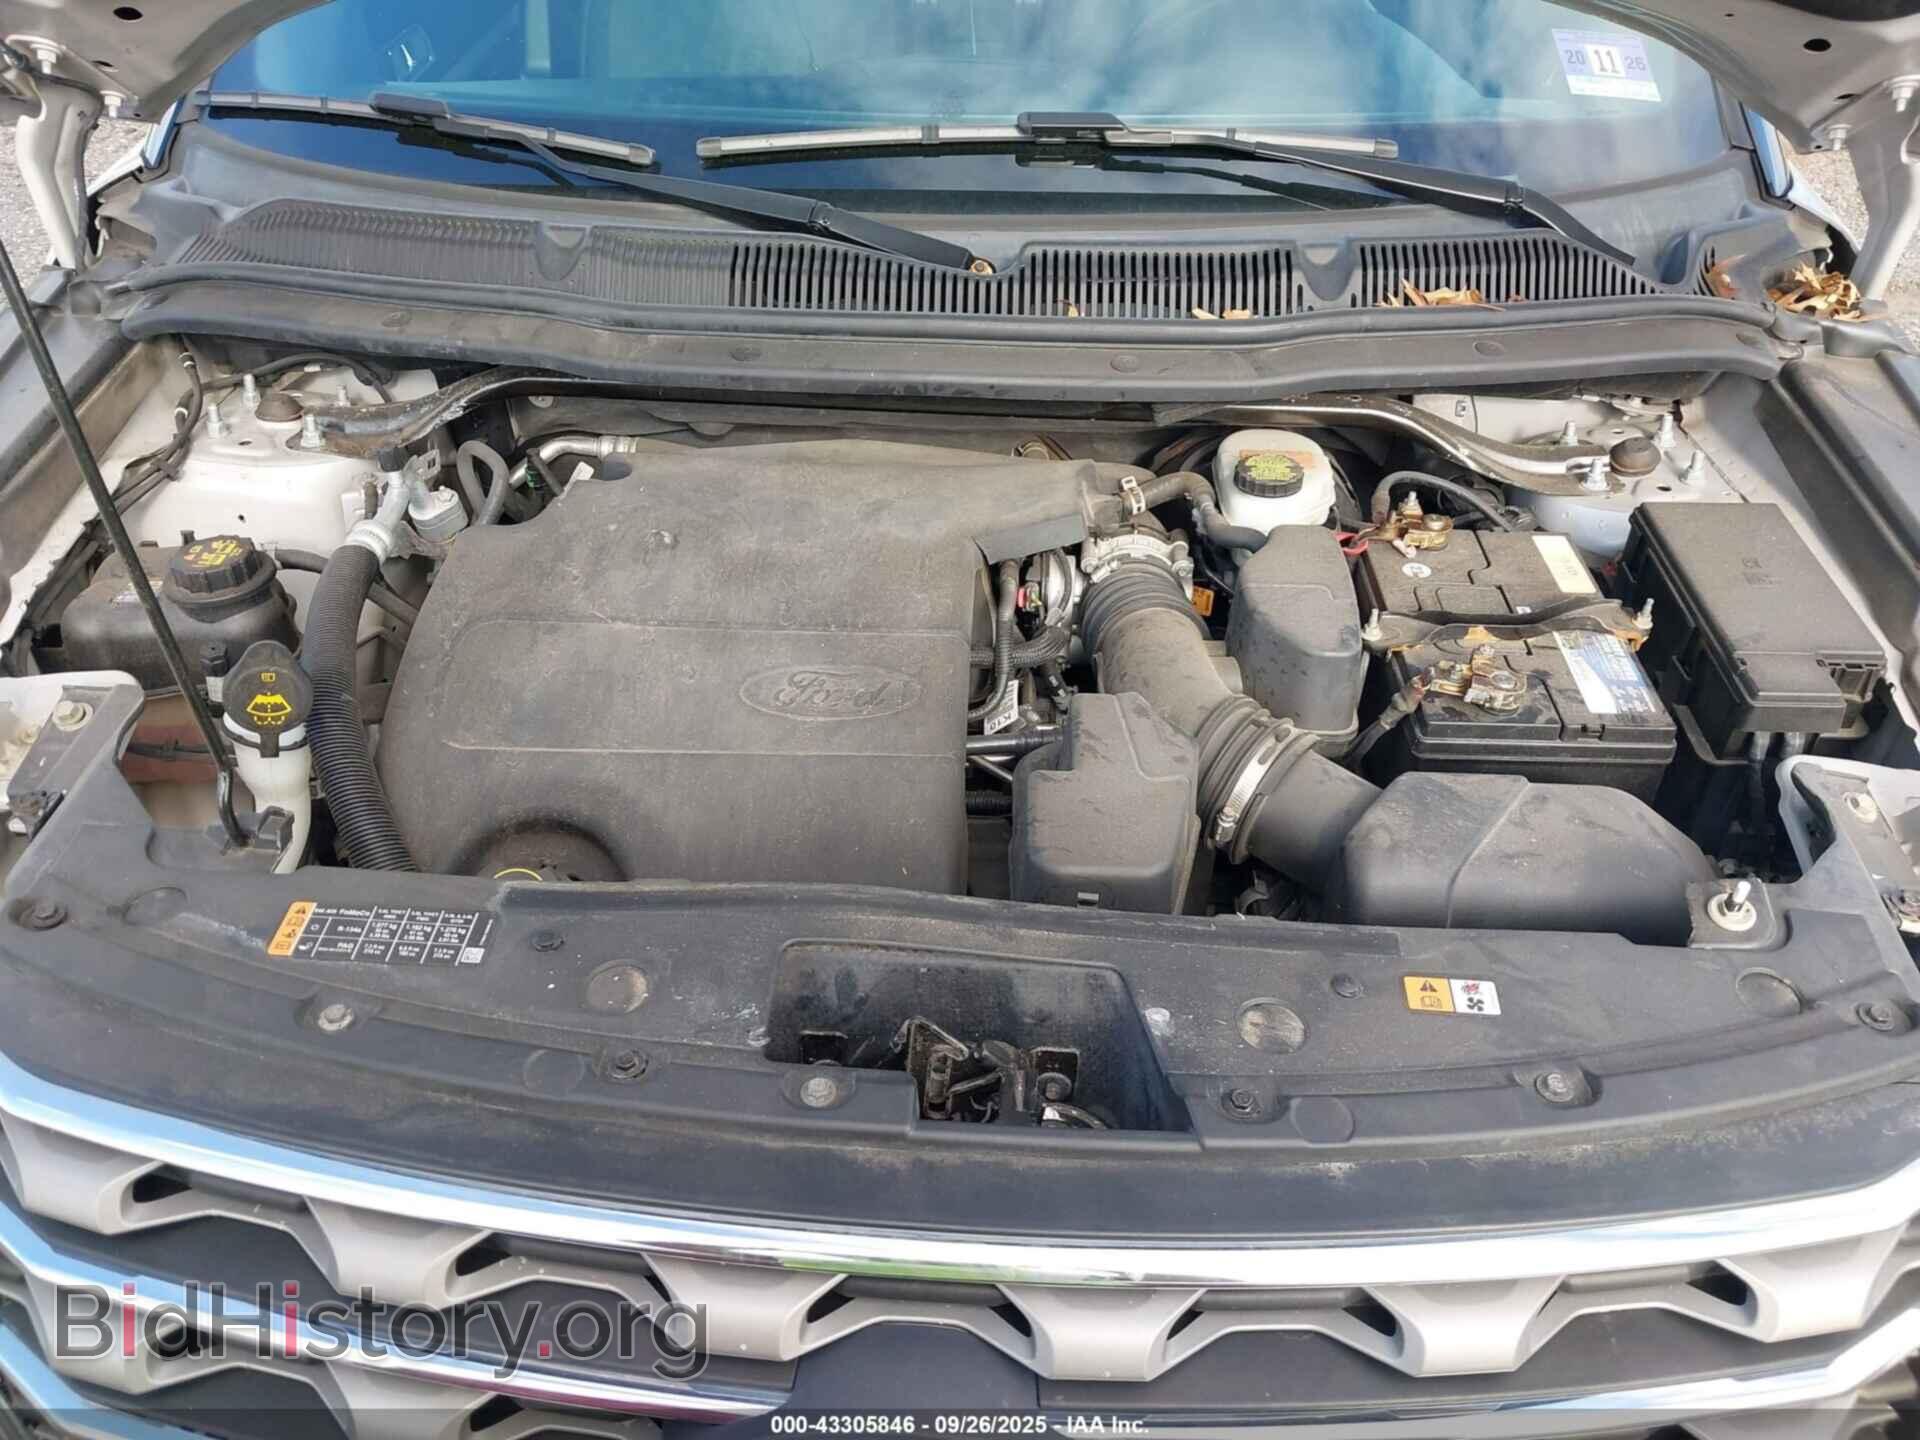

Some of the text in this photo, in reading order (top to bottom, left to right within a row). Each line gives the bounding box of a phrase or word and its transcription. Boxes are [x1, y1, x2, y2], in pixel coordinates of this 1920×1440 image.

[1564, 49, 1585, 65] 20
[1594, 49, 1621, 73] 11
[774, 670, 891, 709] Ford
